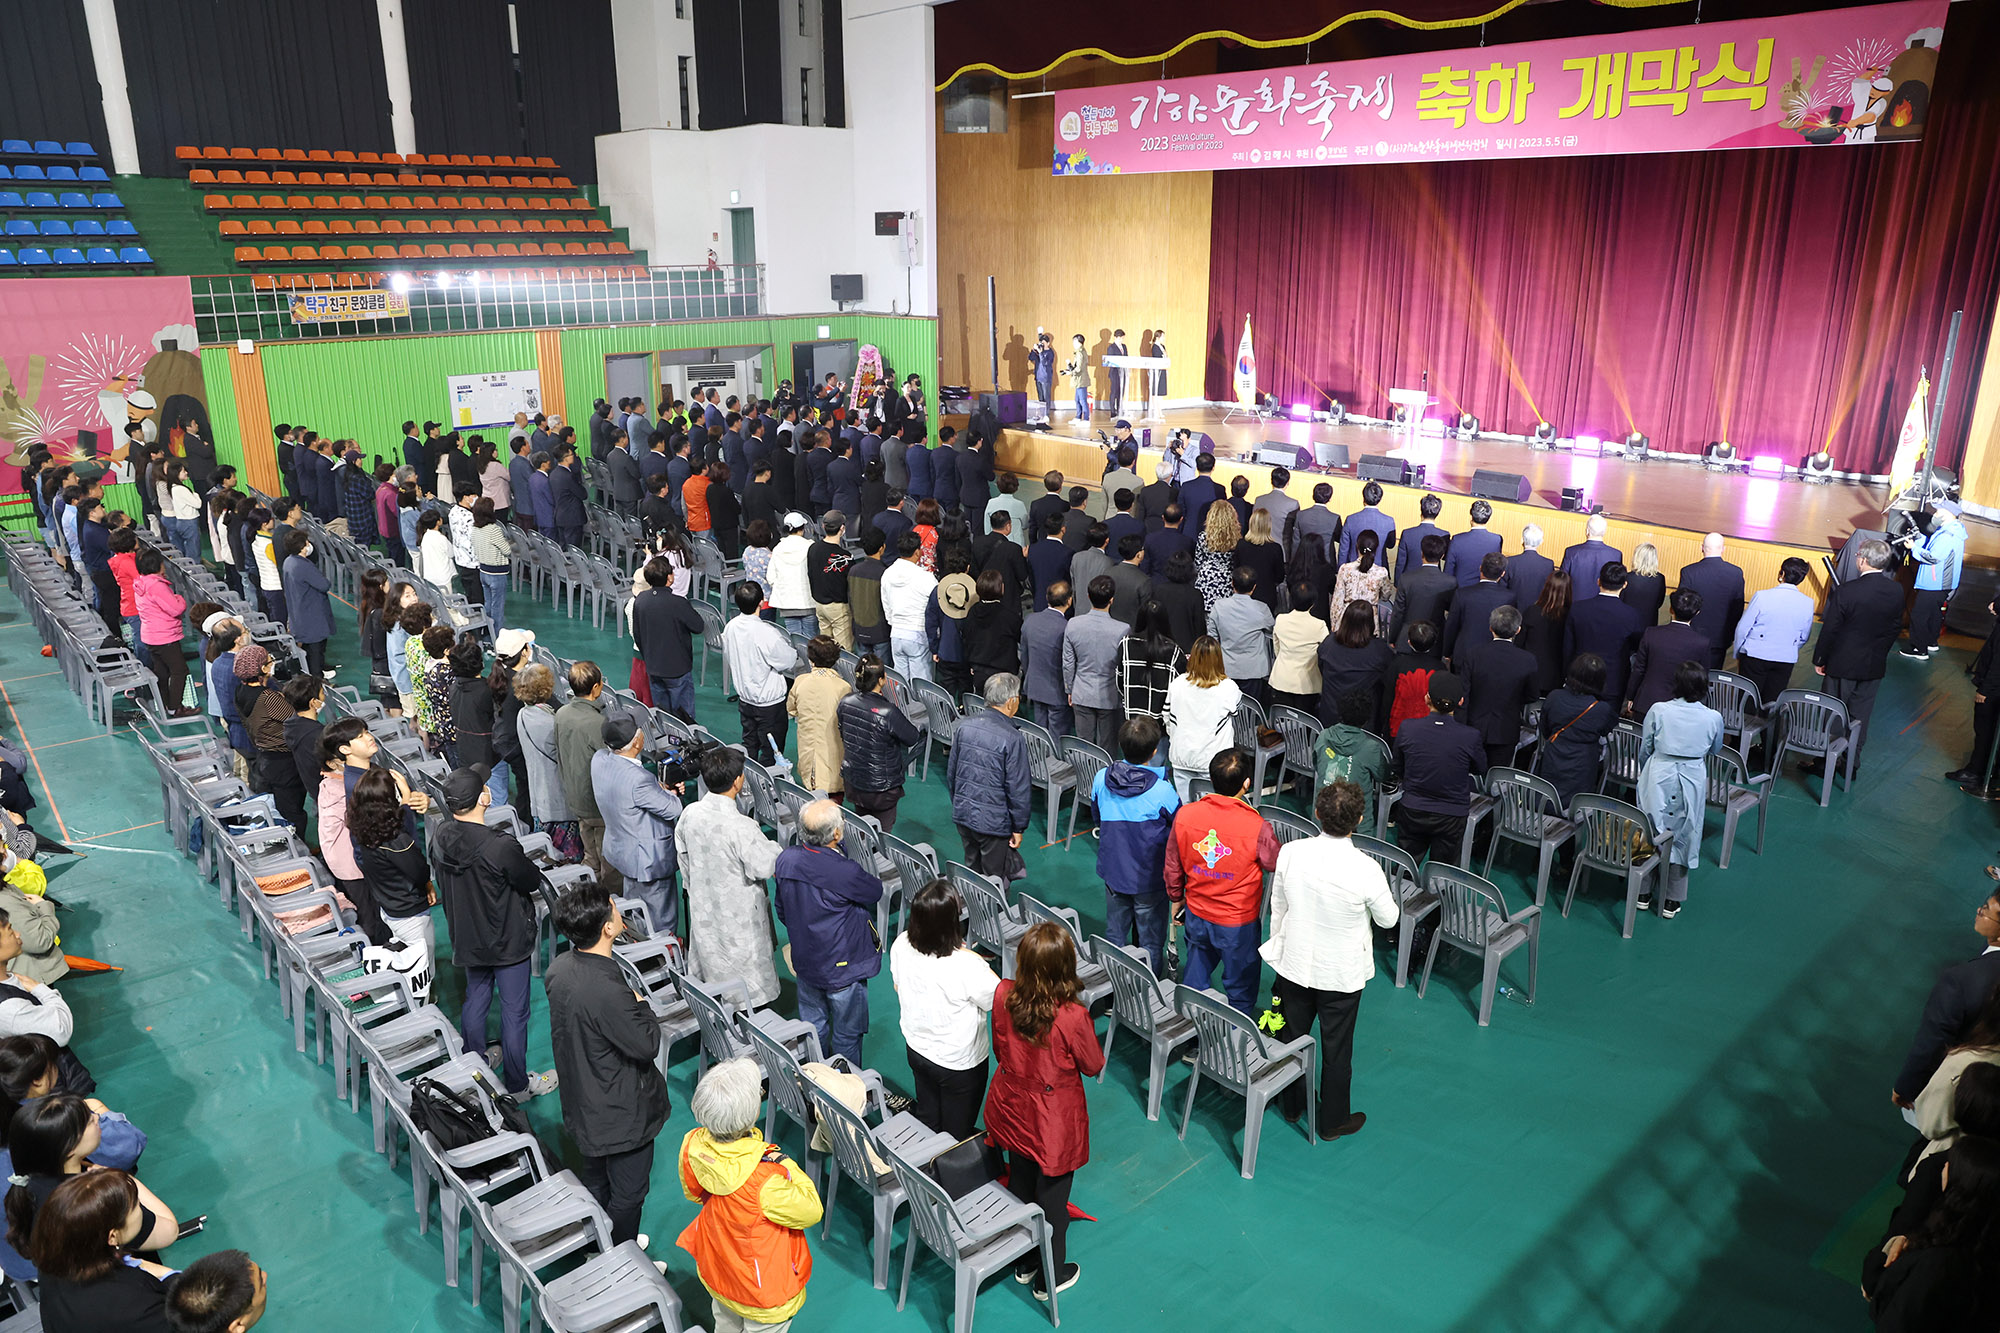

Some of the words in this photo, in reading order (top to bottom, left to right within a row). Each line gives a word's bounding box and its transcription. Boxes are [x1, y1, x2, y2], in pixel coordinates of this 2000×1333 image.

[1415, 61, 1535, 129] 축하
[1558, 37, 1775, 120] 개막식
[1099, 106, 1115, 118] 가야
[1101, 120, 1118, 134] 김해
[1140, 136, 1169, 151] 2023
[1171, 134, 1189, 142] GAYA
[1190, 133, 1215, 141] Culture
[1171, 143, 1196, 151] Festival
[1197, 142, 1205, 150] of
[1205, 140, 1224, 149] 2023
[1264, 149, 1291, 161] 김해시
[1496, 138, 1513, 150] 일시
[1519, 137, 1561, 148] 2023.5.5
[1562, 135, 1578, 147] (금)
[306, 296, 328, 314] 탁구
[330, 297, 347, 312] 친구
[351, 294, 385, 311] 문화클럽
